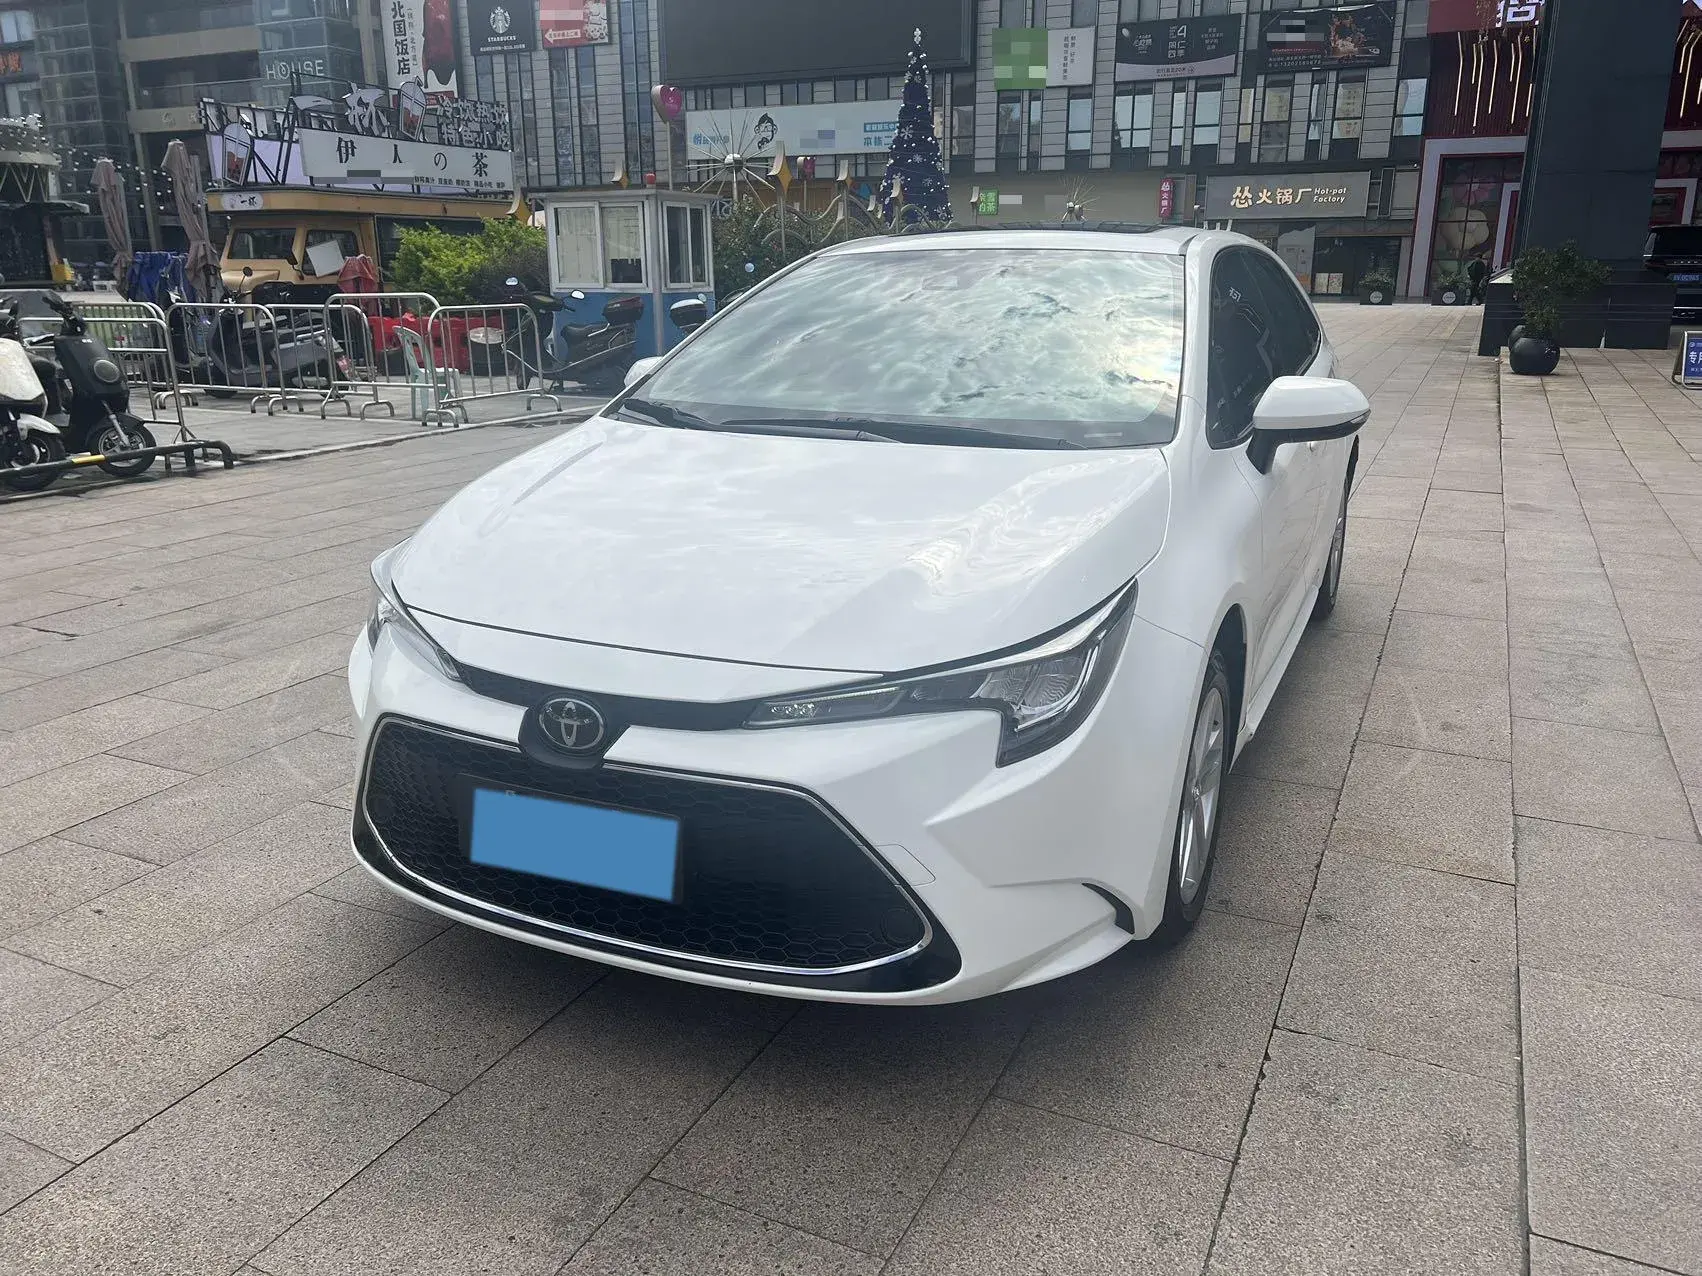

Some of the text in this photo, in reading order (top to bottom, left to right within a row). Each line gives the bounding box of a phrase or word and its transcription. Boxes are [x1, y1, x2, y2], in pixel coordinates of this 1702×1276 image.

[391, 1, 410, 75] 北国饭店
[1178, 25, 1187, 38] 4
[266, 60, 325, 80] HOUSE
[438, 95, 509, 124] 冷饮热饮
[441, 121, 511, 150] 特色小吃
[336, 136, 488, 177] 伊人の茶
[1230, 186, 1312, 208] 怂火锅厂
[1313, 195, 1346, 203] Factory
